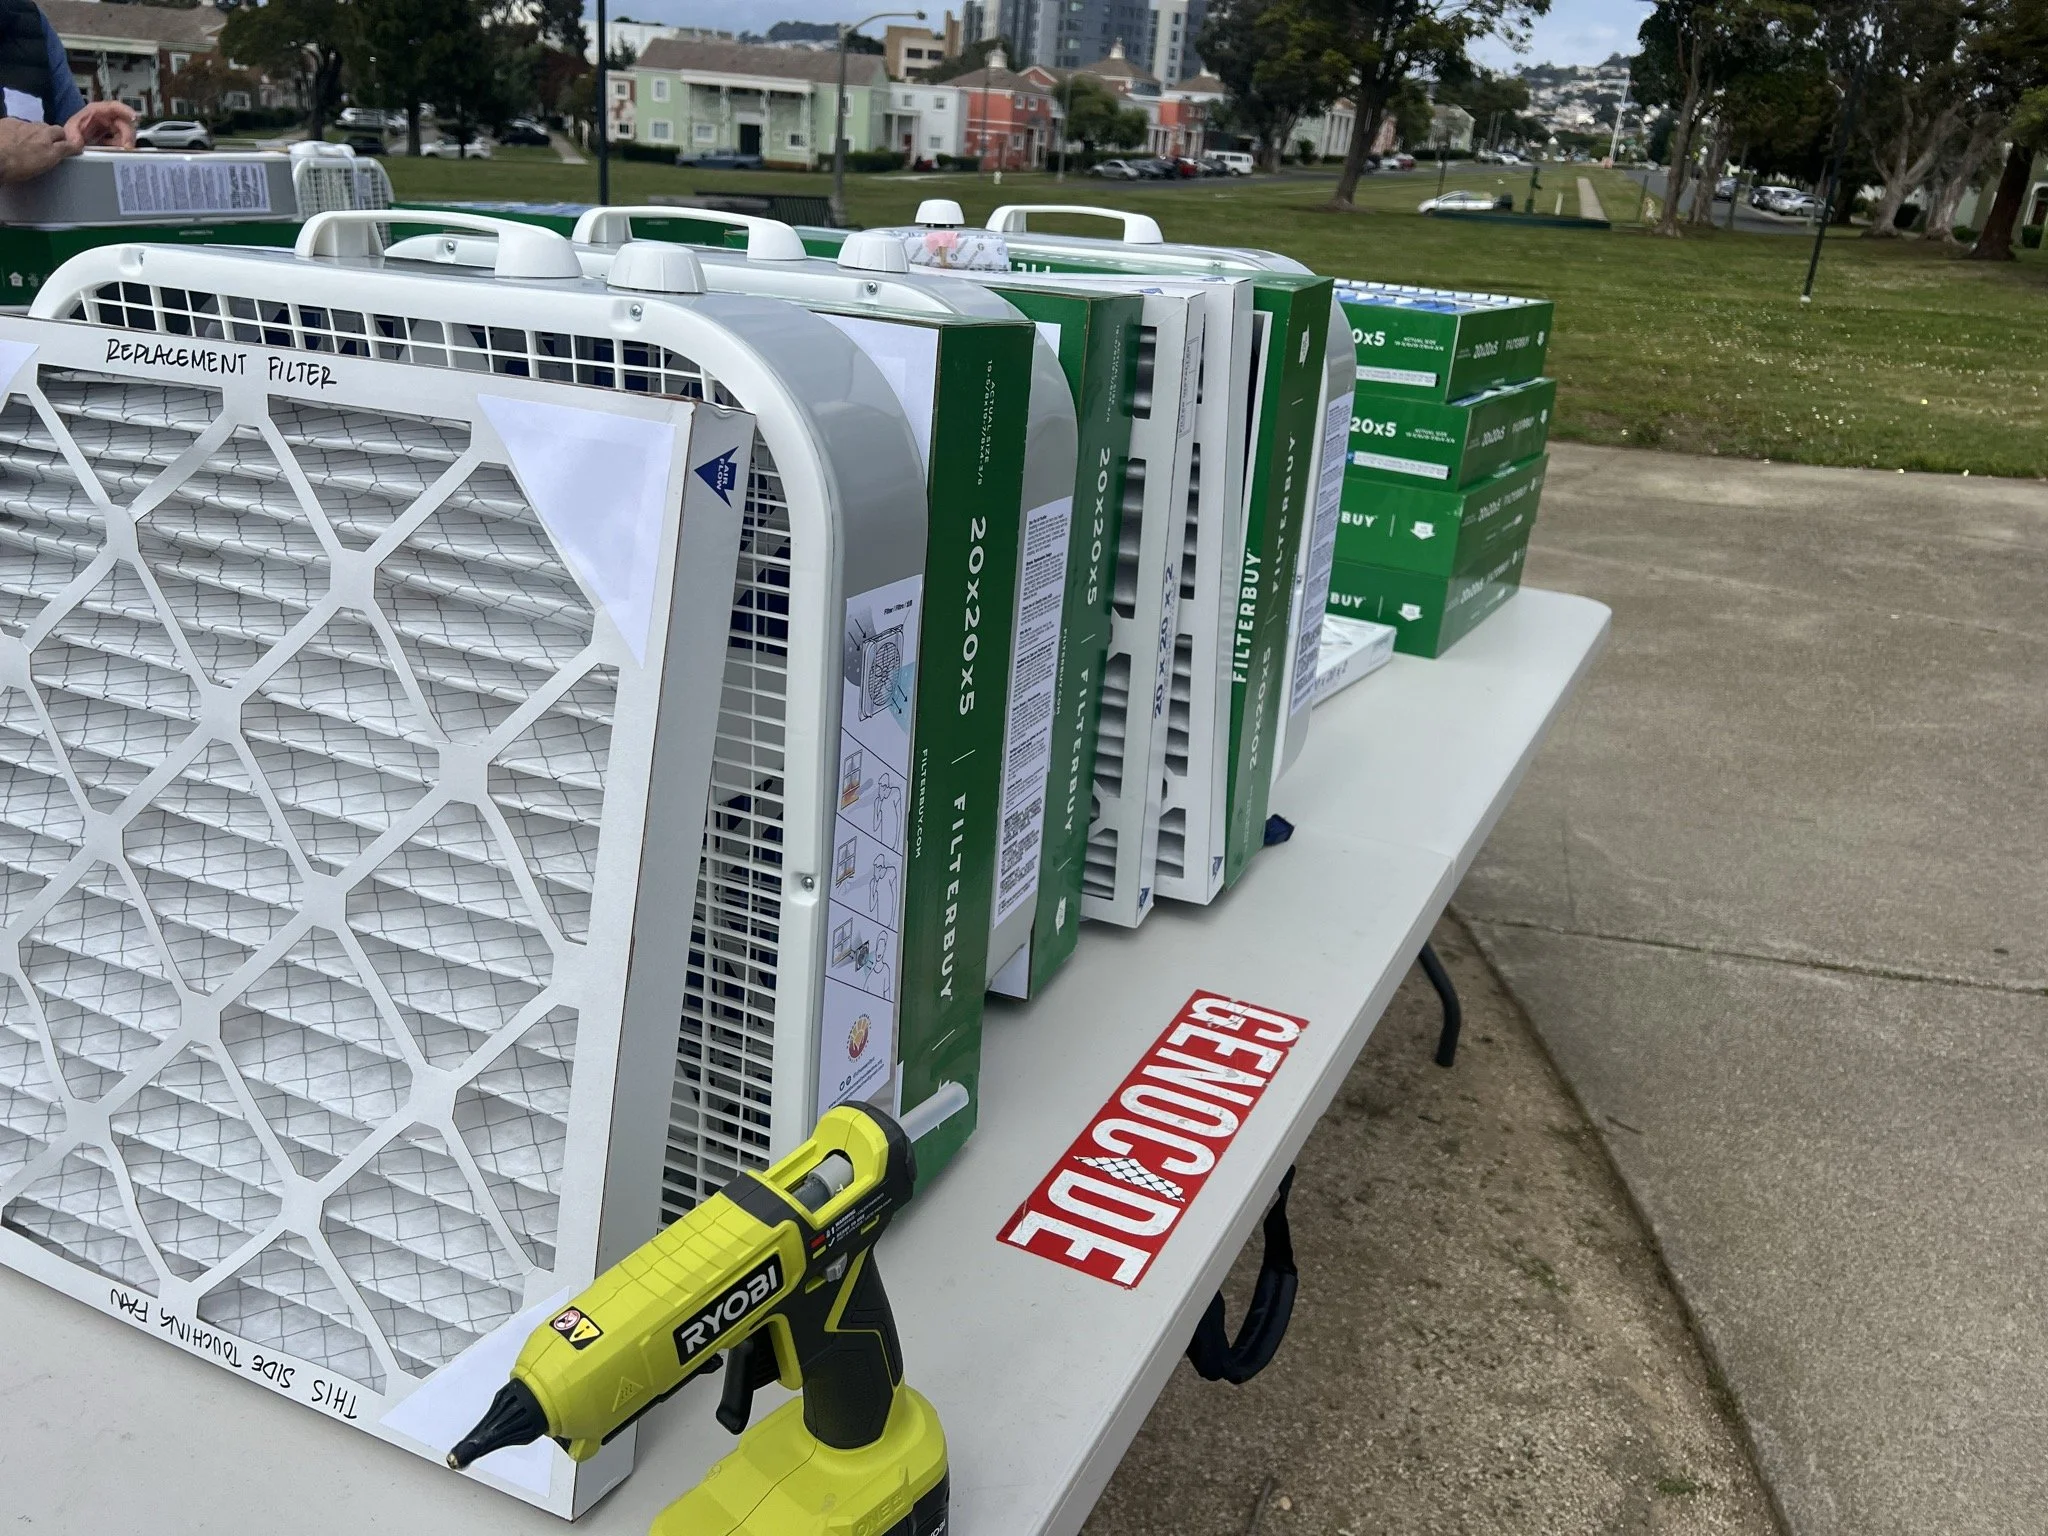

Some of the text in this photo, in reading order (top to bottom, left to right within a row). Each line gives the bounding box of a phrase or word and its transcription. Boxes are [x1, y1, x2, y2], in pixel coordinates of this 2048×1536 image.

[105, 337, 338, 389] REPLACEMENT FILTER
[984, 381, 996, 463] ACTUAL SIZE
[716, 458, 725, 490] FLOW
[722, 465, 730, 485] AIR
[1350, 416, 1397, 438] 20x5
[1272, 432, 1296, 595] FILTERBUY
[1056, 627, 1068, 716] FILTERBUY.COM
[1063, 447, 1111, 834] 20x20x5 FILTERBUY
[1154, 683, 1164, 720] 20
[1160, 616, 1169, 653] 20
[1166, 562, 1174, 585] 2
[1232, 552, 1262, 685] FILTERBUY
[939, 516, 988, 999] 20x20x5 FILTERBUY
[1249, 646, 1271, 771] 20x20x5
[915, 747, 929, 859] FILTERBUY.COM
[1007, 997, 1301, 1286] GENOCIDE
[109, 1287, 358, 1420] THIS SIDE TOUCHING FAN
[680, 1264, 778, 1355] RYOBI
